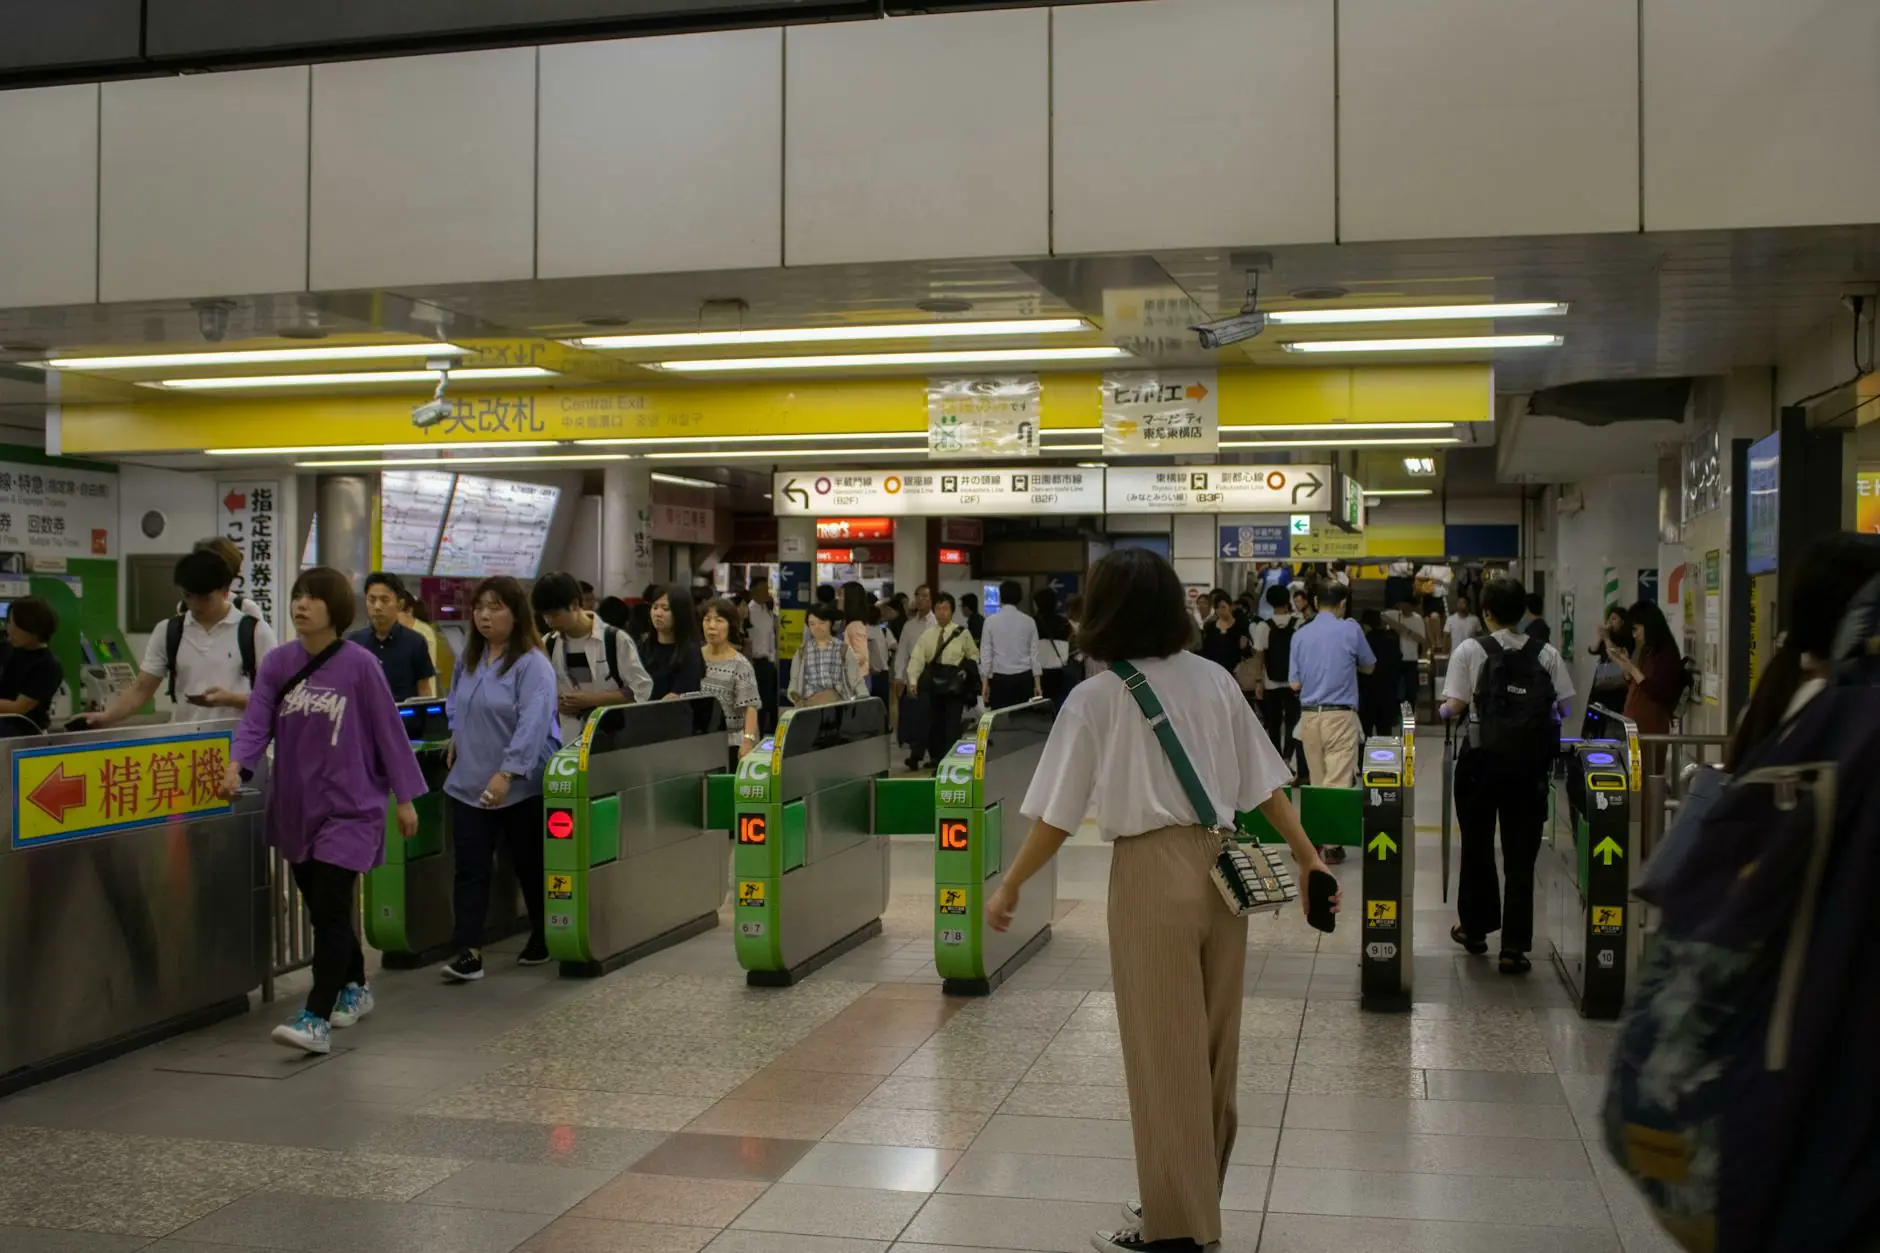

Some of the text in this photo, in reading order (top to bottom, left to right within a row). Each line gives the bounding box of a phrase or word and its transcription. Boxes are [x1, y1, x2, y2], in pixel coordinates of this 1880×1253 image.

[560, 395, 645, 412] Central Exit
[412, 397, 545, 435] 央改札
[960, 475, 1001, 485] 井の頭線
[1031, 474, 1083, 485] 田園都市線
[1221, 471, 1265, 482] 副都心線
[833, 496, 860, 506] (B2F)
[959, 495, 981, 505] (2F)
[1196, 492, 1225, 503] (B3F)
[549, 756, 578, 776] IC
[738, 760, 770, 780] IC
[939, 764, 972, 785] IC
[97, 747, 226, 820] 精算機
[739, 785, 764, 799] 専用
[940, 790, 966, 804] 専用
[741, 818, 766, 842] IC
[942, 823, 967, 848] IC
[1602, 952, 1612, 963] 10
